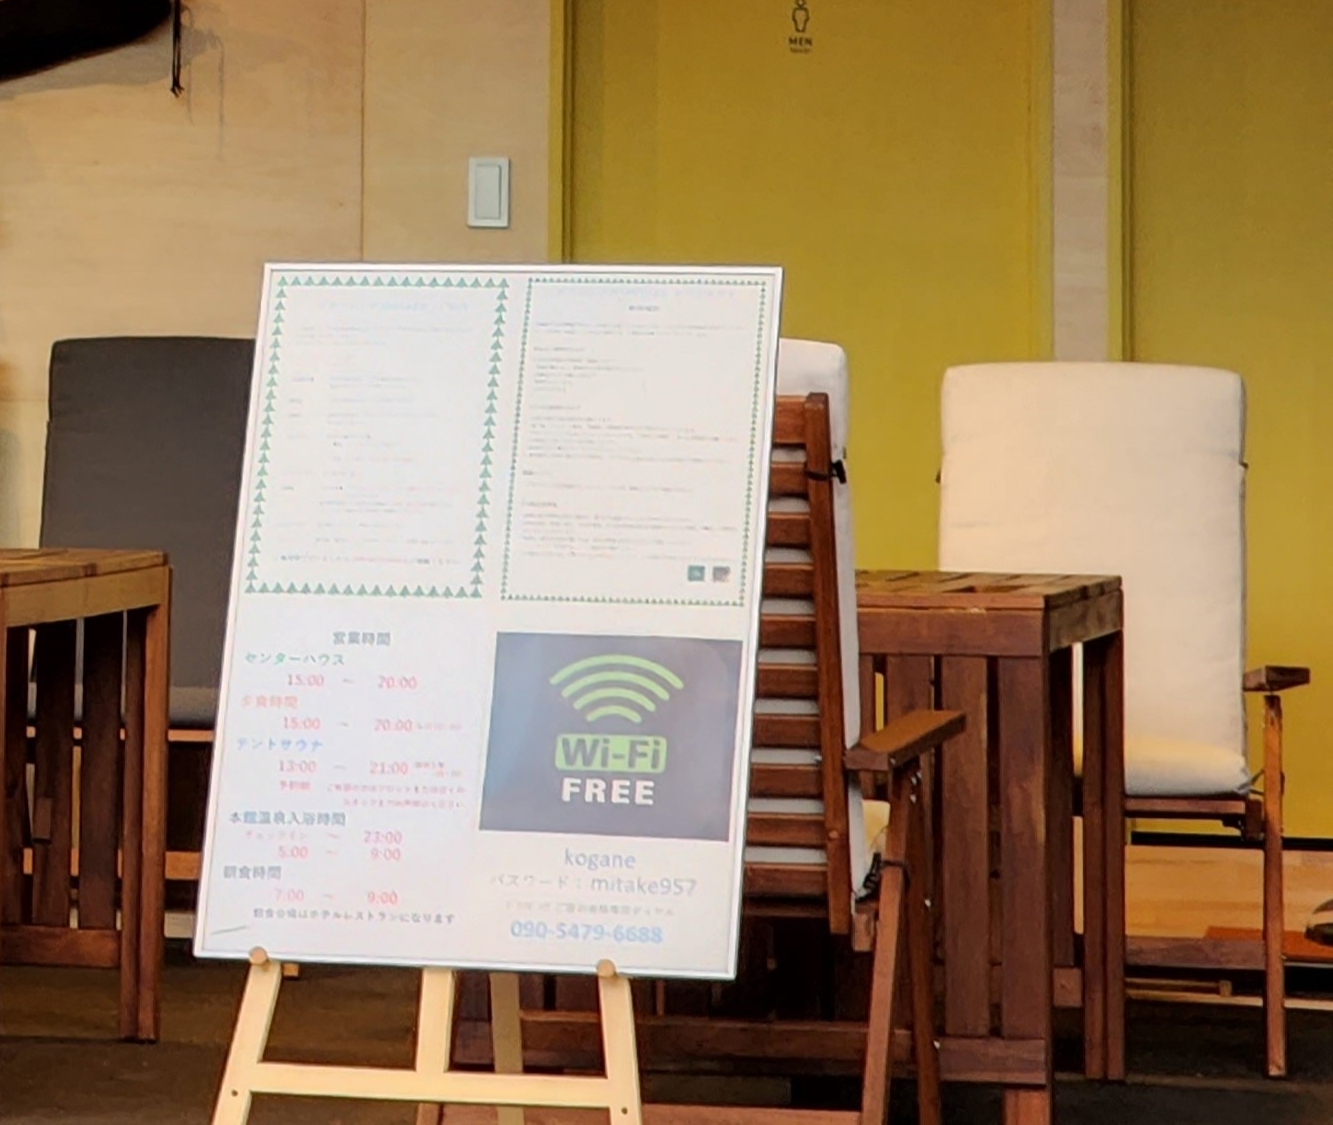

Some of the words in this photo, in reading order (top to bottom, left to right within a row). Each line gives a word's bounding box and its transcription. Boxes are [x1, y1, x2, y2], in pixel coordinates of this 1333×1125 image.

[244, 652, 345, 666] センターハウス
[287, 674, 325, 687] 15:00
[377, 675, 418, 690] 20:00
[283, 716, 322, 730] 15:00
[237, 738, 323, 752] テントサウナ
[561, 737, 661, 770] Wi-Fi
[369, 760, 410, 775] 21:00
[561, 776, 655, 806] FREE
[564, 848, 637, 871] kogane
[510, 920, 665, 944] 090-5479-6688
